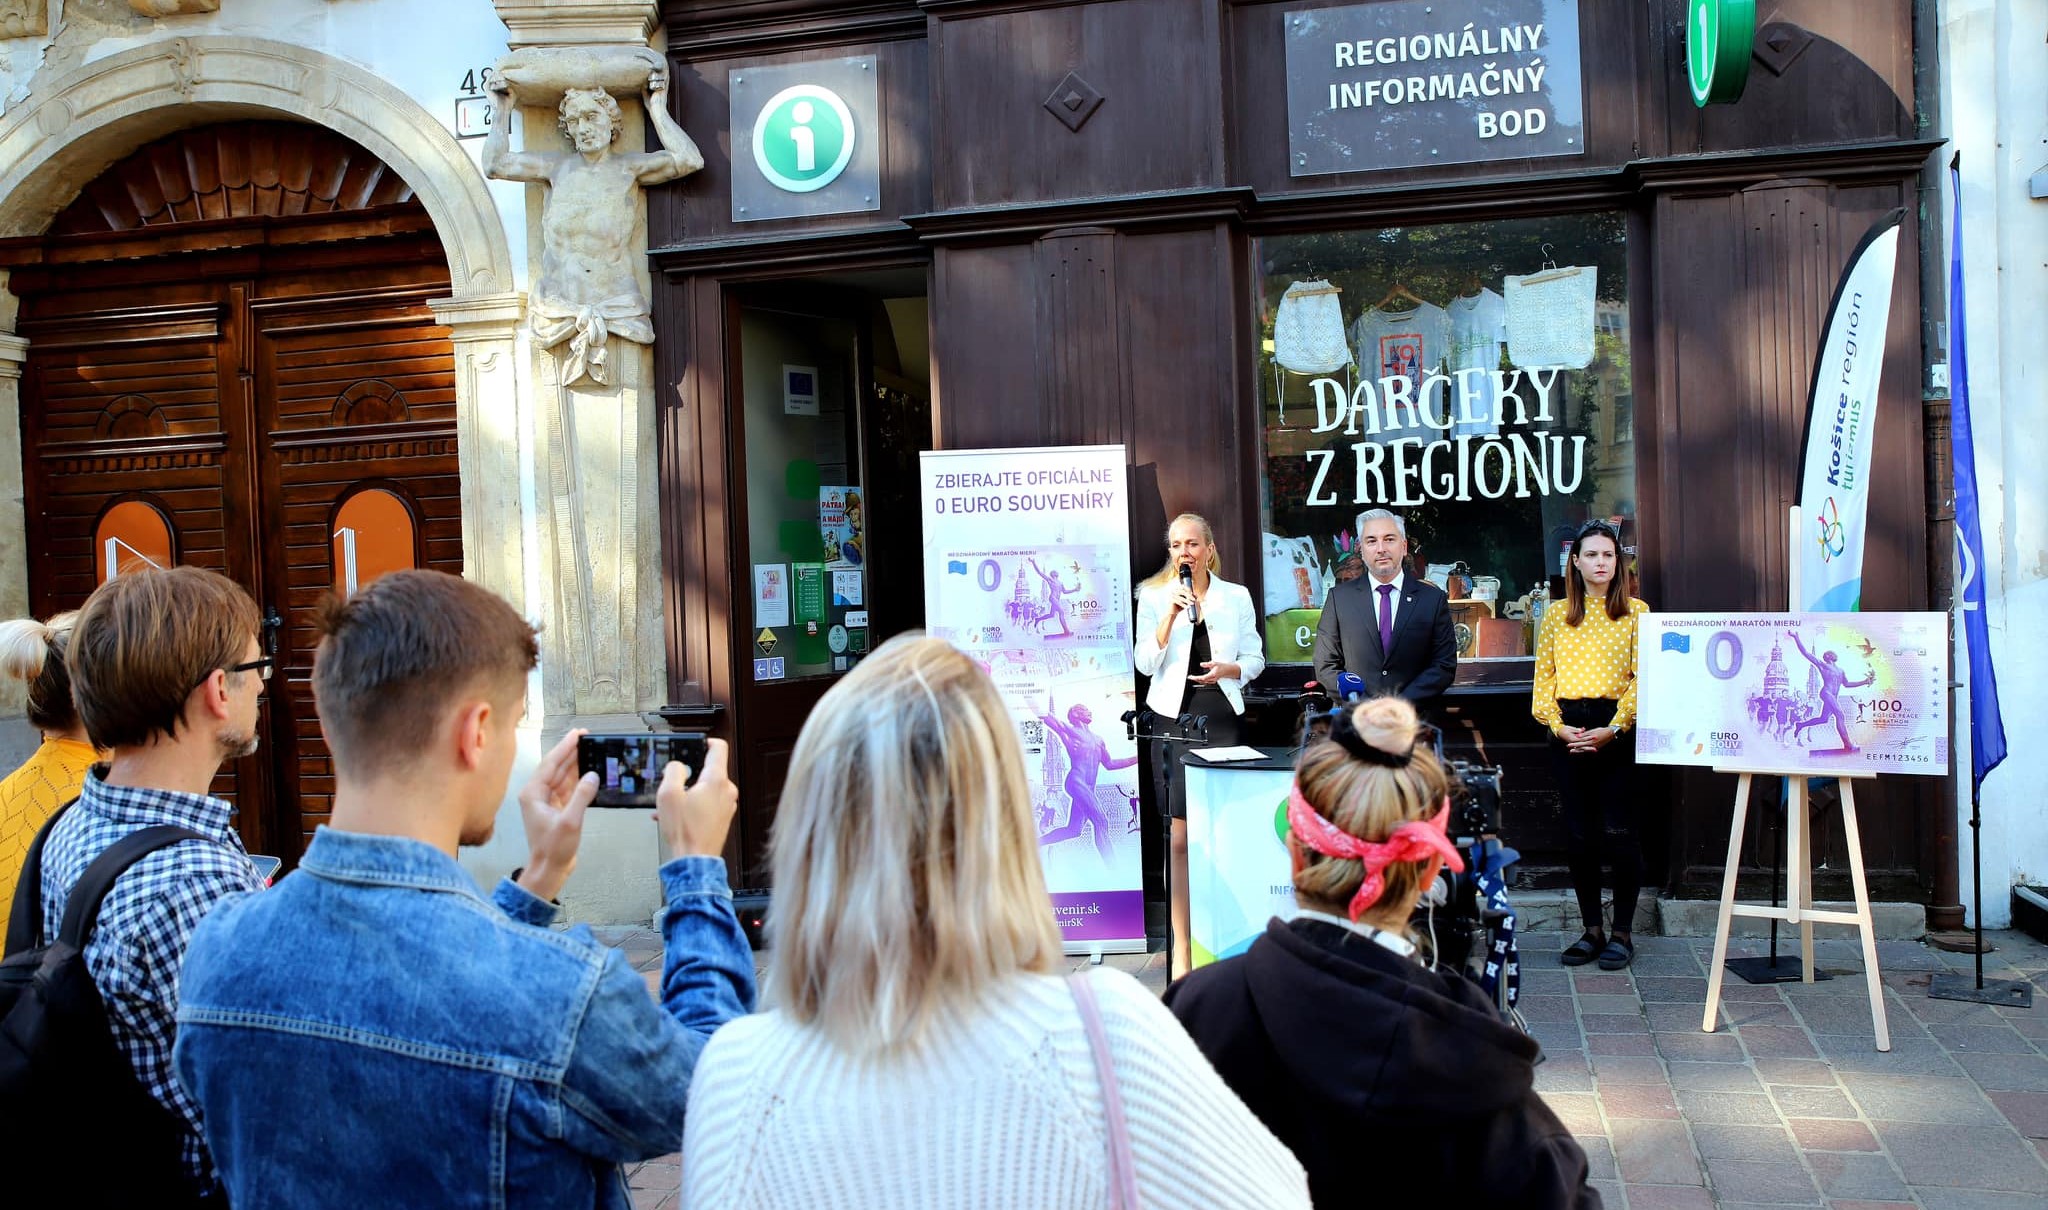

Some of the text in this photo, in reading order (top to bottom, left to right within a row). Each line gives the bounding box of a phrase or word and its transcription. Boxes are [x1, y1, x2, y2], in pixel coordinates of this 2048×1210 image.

[1334, 22, 1544, 68] REGIONÁLNY
[1329, 58, 1545, 110] INFORMAČNÝ
[1478, 108, 1547, 139] BOD
[1308, 366, 1560, 435] DARČEKY
[1827, 292, 1862, 487] Košice región
[1841, 400, 1861, 490] turizmus
[935, 467, 1113, 489] ZBIERAJTE OFICIÁLNE
[1305, 450, 1338, 507] Z
[935, 489, 1114, 514] 0 EURO SOUVENÍRY
[977, 559, 1002, 592] 0
[1079, 600, 1098, 609] 100
[1661, 619, 1726, 627] MEDZINÁRODNÝ
[1730, 619, 1772, 627] MARATÓN
[1705, 631, 1744, 680] 0
[1871, 699, 1902, 712] 100
[1710, 732, 1739, 740] EURO
[1866, 753, 1929, 763] EEFM123456
